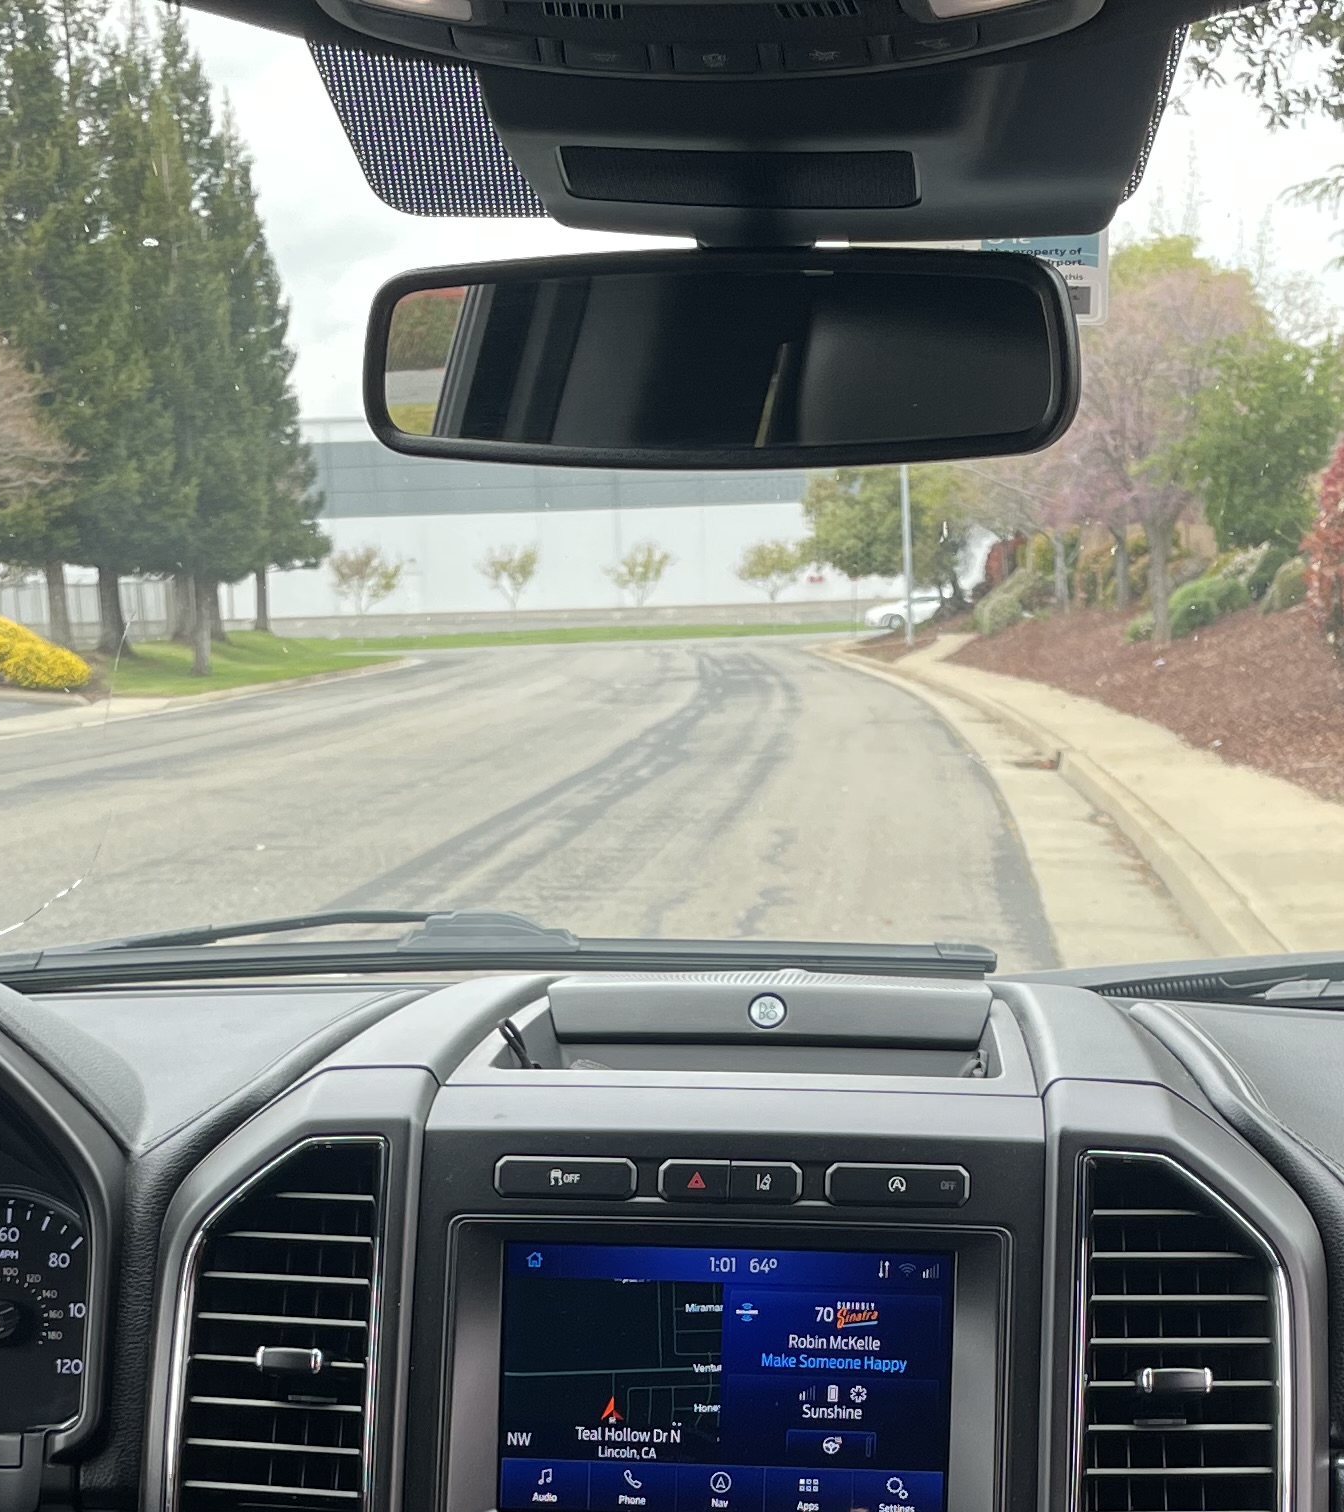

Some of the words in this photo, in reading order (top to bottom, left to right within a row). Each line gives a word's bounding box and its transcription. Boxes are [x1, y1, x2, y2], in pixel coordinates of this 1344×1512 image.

[1069, 247, 1082, 255] of
[563, 1173, 580, 1184] OFF
[940, 1180, 957, 1191] OFF
[48, 1252, 71, 1268] 80
[709, 1256, 737, 1273] 1:01
[2, 1267, 18, 1277] 100
[26, 1274, 41, 1283] 120
[42, 1289, 58, 1299] 140
[49, 1309, 64, 1319] 160
[814, 1306, 834, 1322] 70
[836, 1308, 879, 1329] Sinatra
[47, 1330, 63, 1340] 180
[788, 1334, 827, 1349] Robin
[830, 1335, 881, 1351] McKelle
[56, 1358, 84, 1375] 120
[761, 1353, 797, 1368] Make
[799, 1354, 861, 1369] Someone
[864, 1356, 907, 1373] Happy
[802, 1404, 863, 1420] Sunshine
[507, 1431, 532, 1446] NW
[575, 1426, 602, 1441] Teal
[604, 1427, 651, 1443] Hollow
[653, 1429, 668, 1443] Dr
[670, 1429, 681, 1444] N
[598, 1446, 640, 1460] Lincoln,
[642, 1446, 657, 1459] CA
[532, 1492, 558, 1503] Audio
[618, 1494, 646, 1506] Phone
[711, 1498, 729, 1508] Nav
[796, 1501, 819, 1512] Apps
